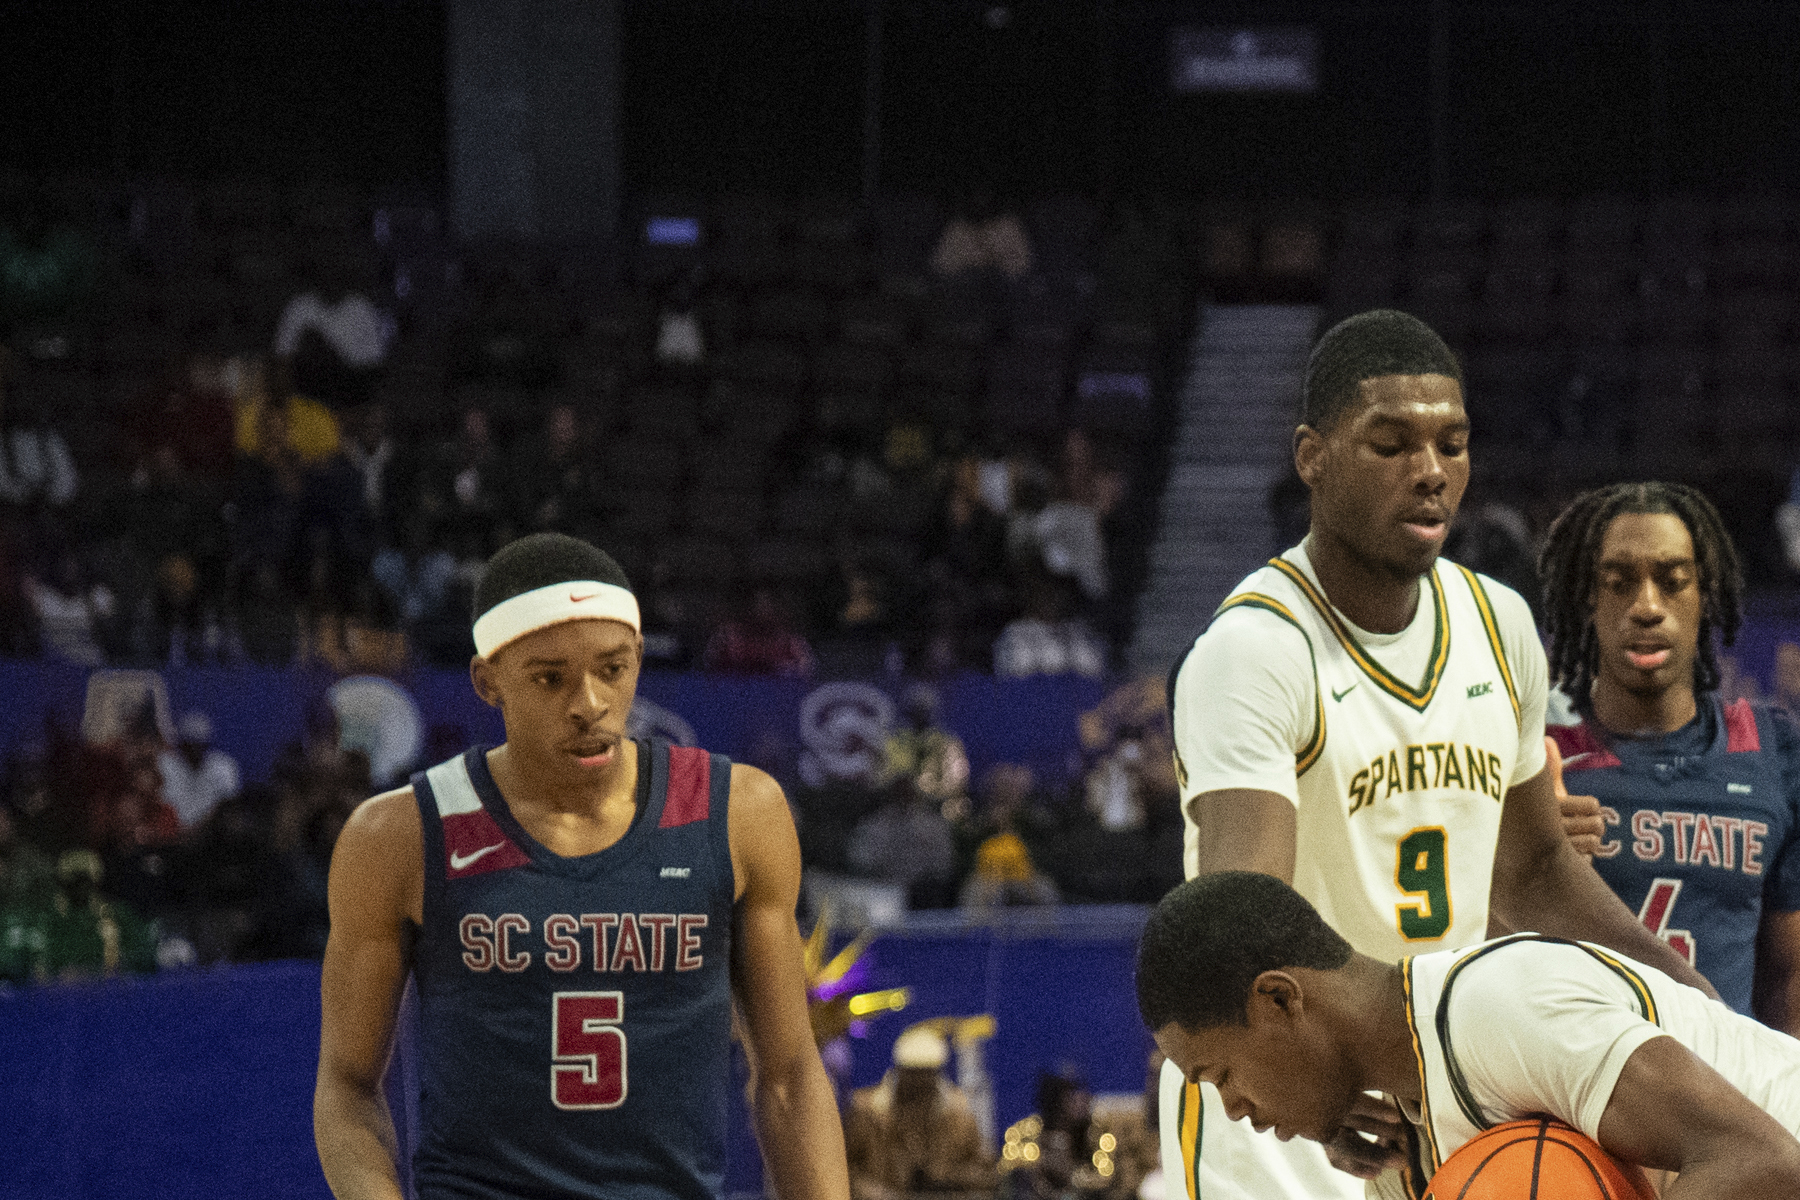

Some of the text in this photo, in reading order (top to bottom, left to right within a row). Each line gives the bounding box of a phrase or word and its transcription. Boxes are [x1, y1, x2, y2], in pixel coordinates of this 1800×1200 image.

[1466, 681, 1493, 699] MEAC
[1349, 741, 1501, 817] SPARTANS
[1631, 809, 1768, 876] STATE
[1394, 825, 1453, 943] 9
[459, 913, 708, 973] SC STATE
[551, 991, 628, 1110] 5
